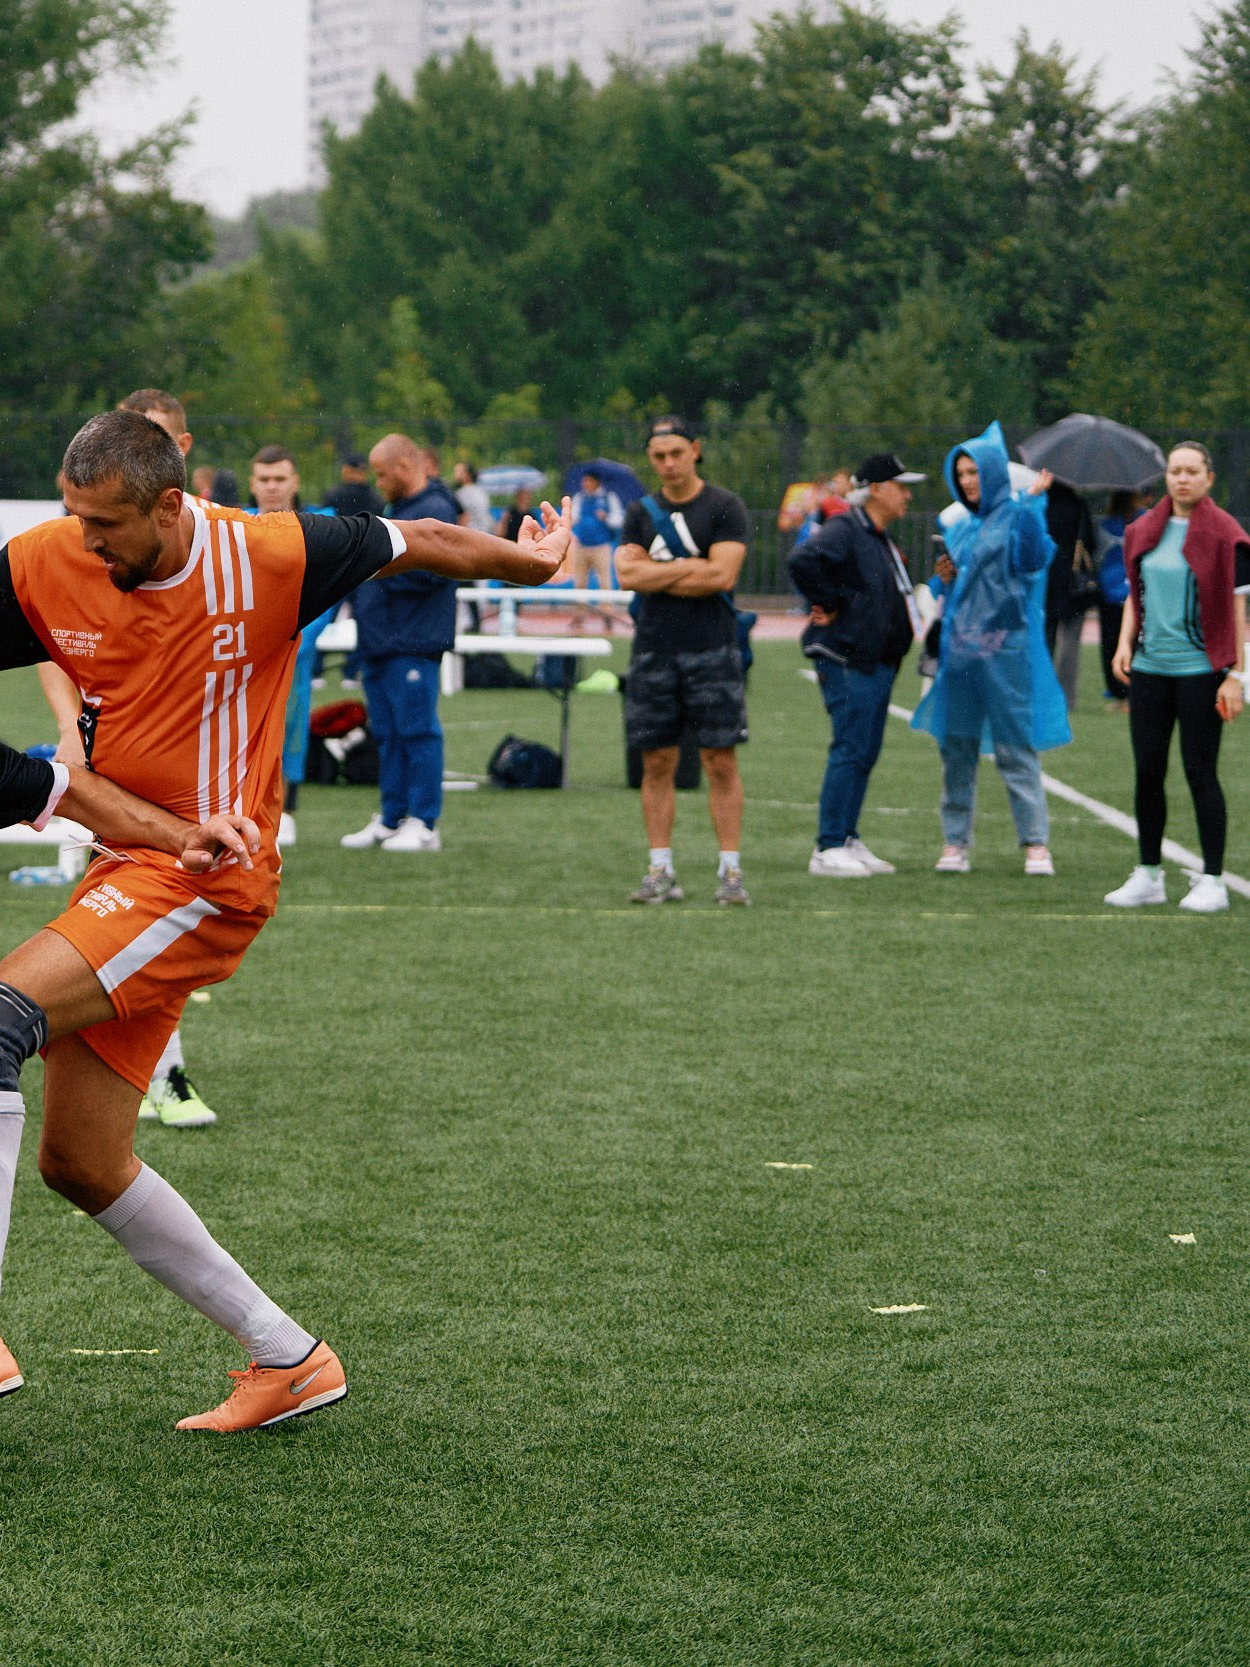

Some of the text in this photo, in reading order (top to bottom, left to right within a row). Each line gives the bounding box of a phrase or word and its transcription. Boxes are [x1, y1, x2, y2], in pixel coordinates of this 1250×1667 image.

[51, 629, 102, 640] СПОРТИВНЫЙ
[213, 621, 247, 662] 21
[60, 647, 94, 657] СЭНЕРГО
